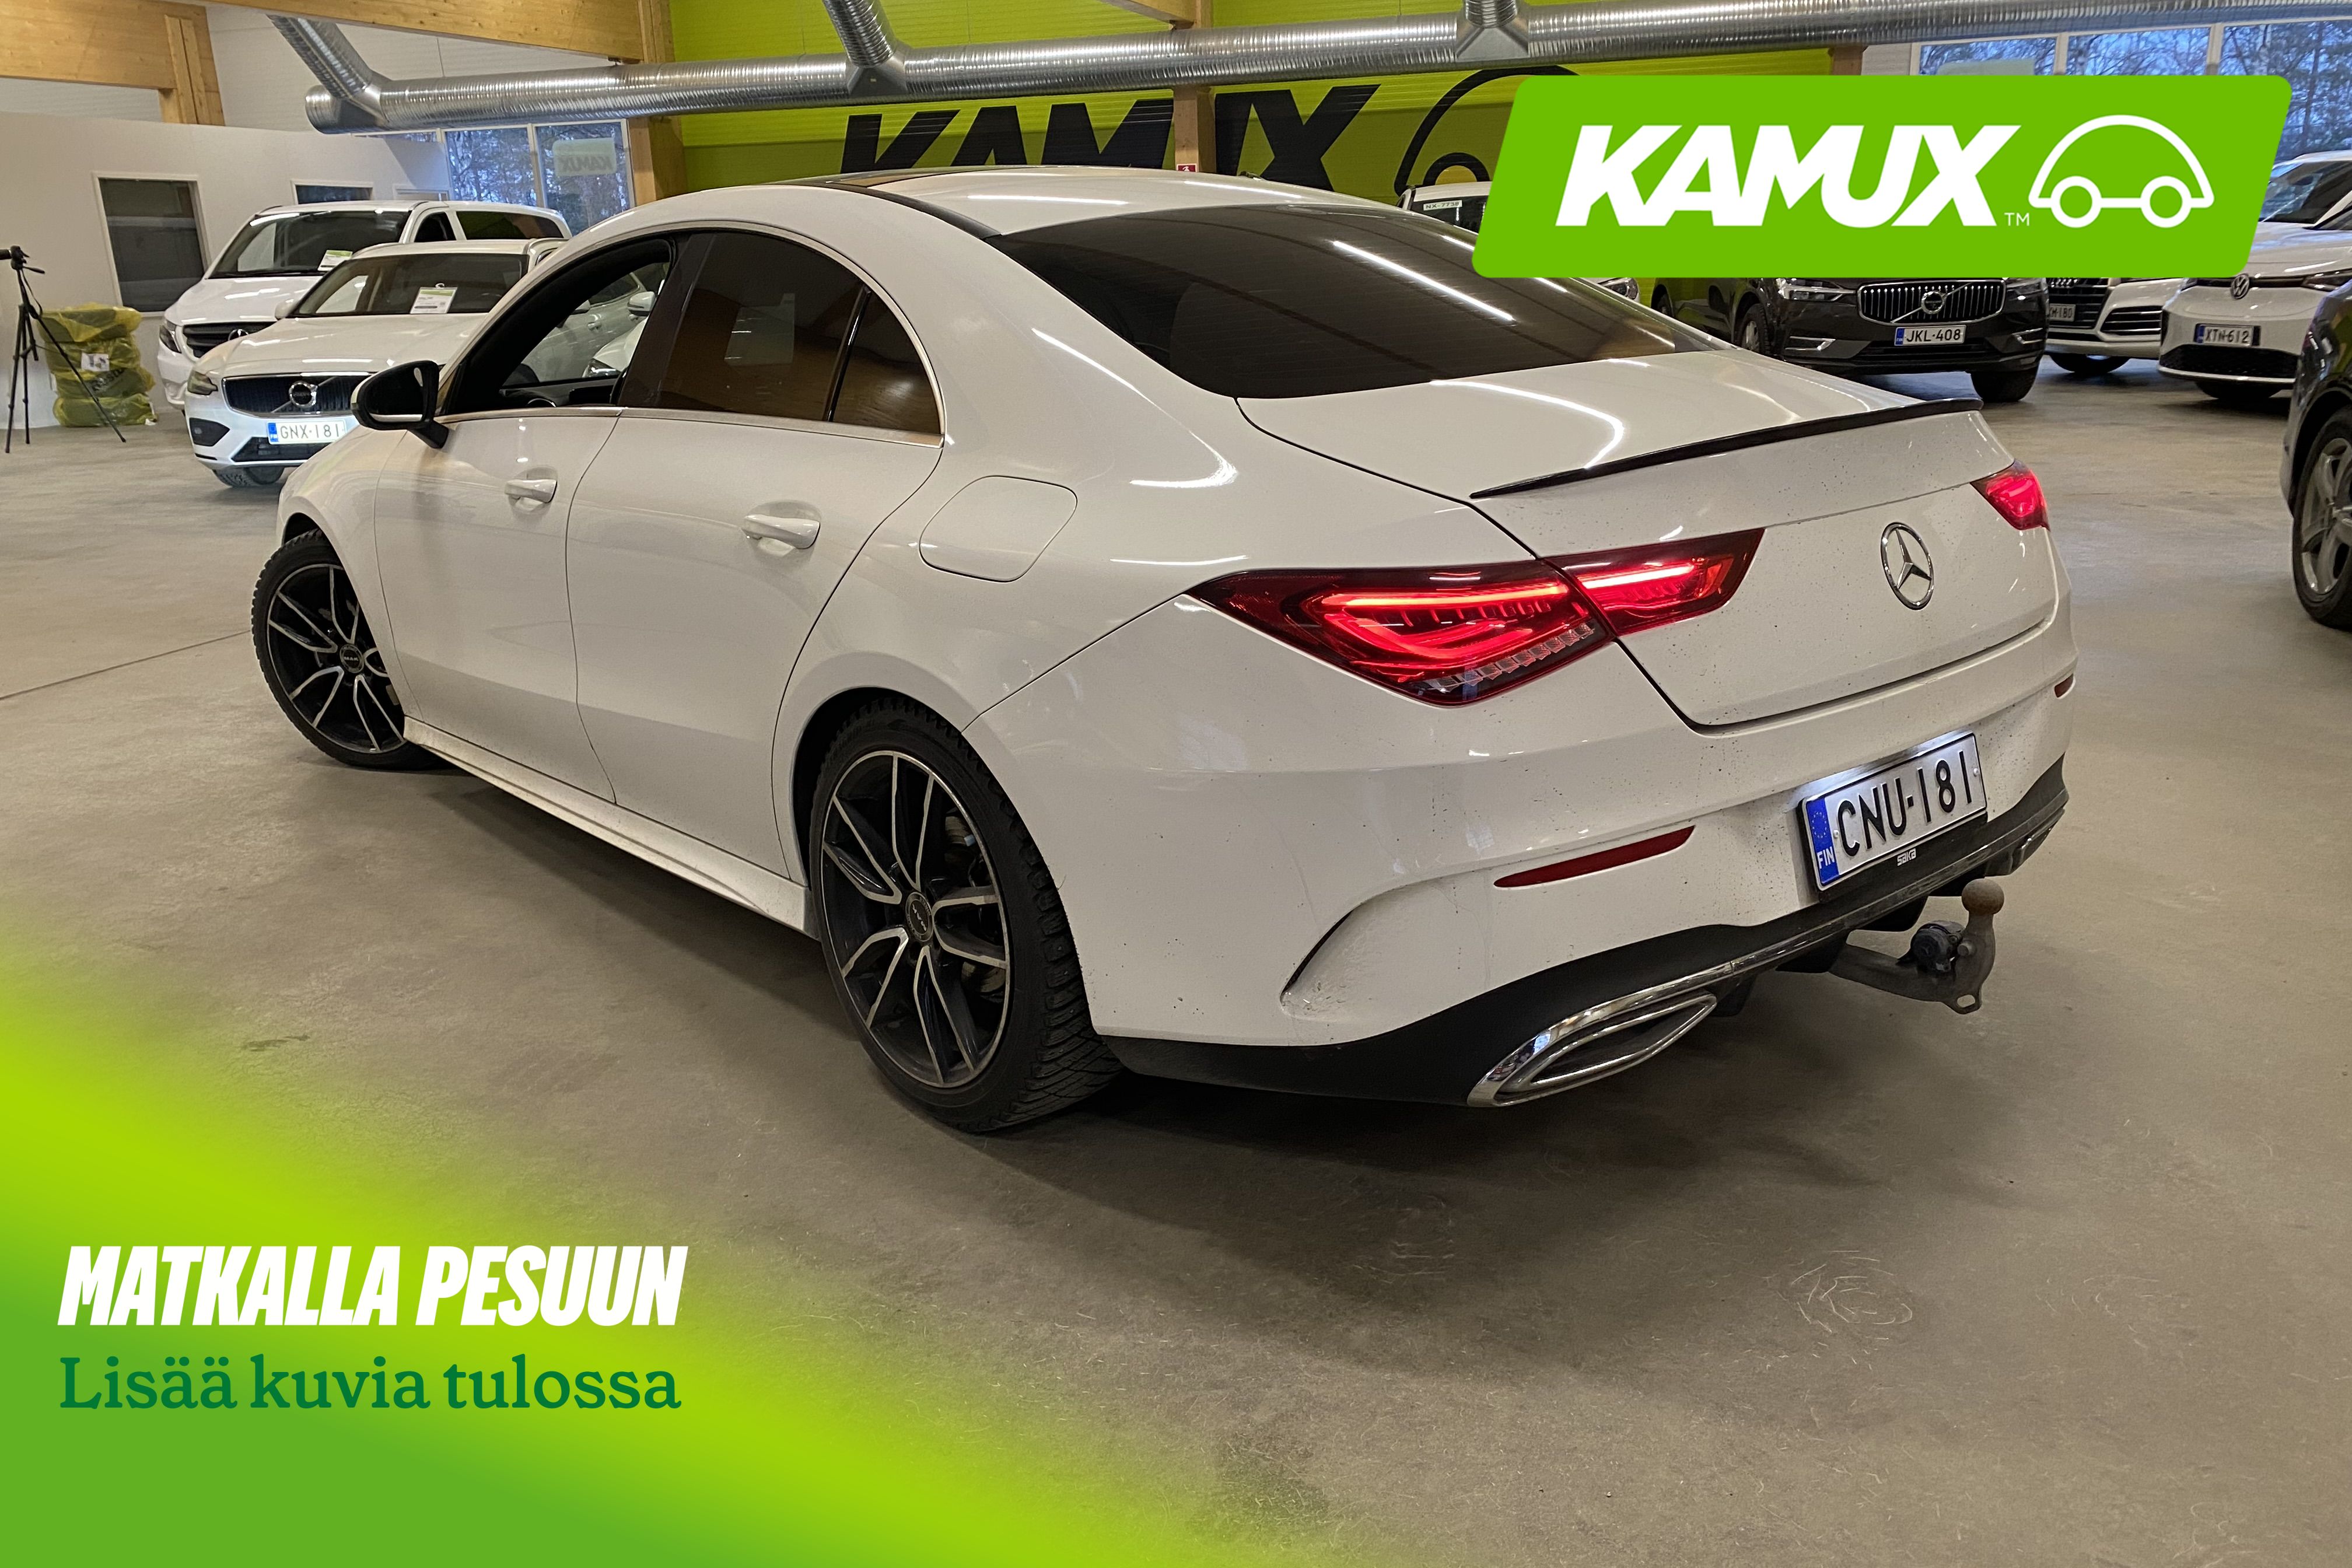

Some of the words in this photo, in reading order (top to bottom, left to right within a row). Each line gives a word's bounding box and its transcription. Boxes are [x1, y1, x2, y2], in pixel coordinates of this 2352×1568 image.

[1906, 328, 1961, 342] JKL-408
[2205, 328, 2250, 344] XTN-612
[279, 423, 340, 439] GNX-181
[1817, 846, 1835, 869] FIN
[1838, 750, 1972, 858] CNU-181
